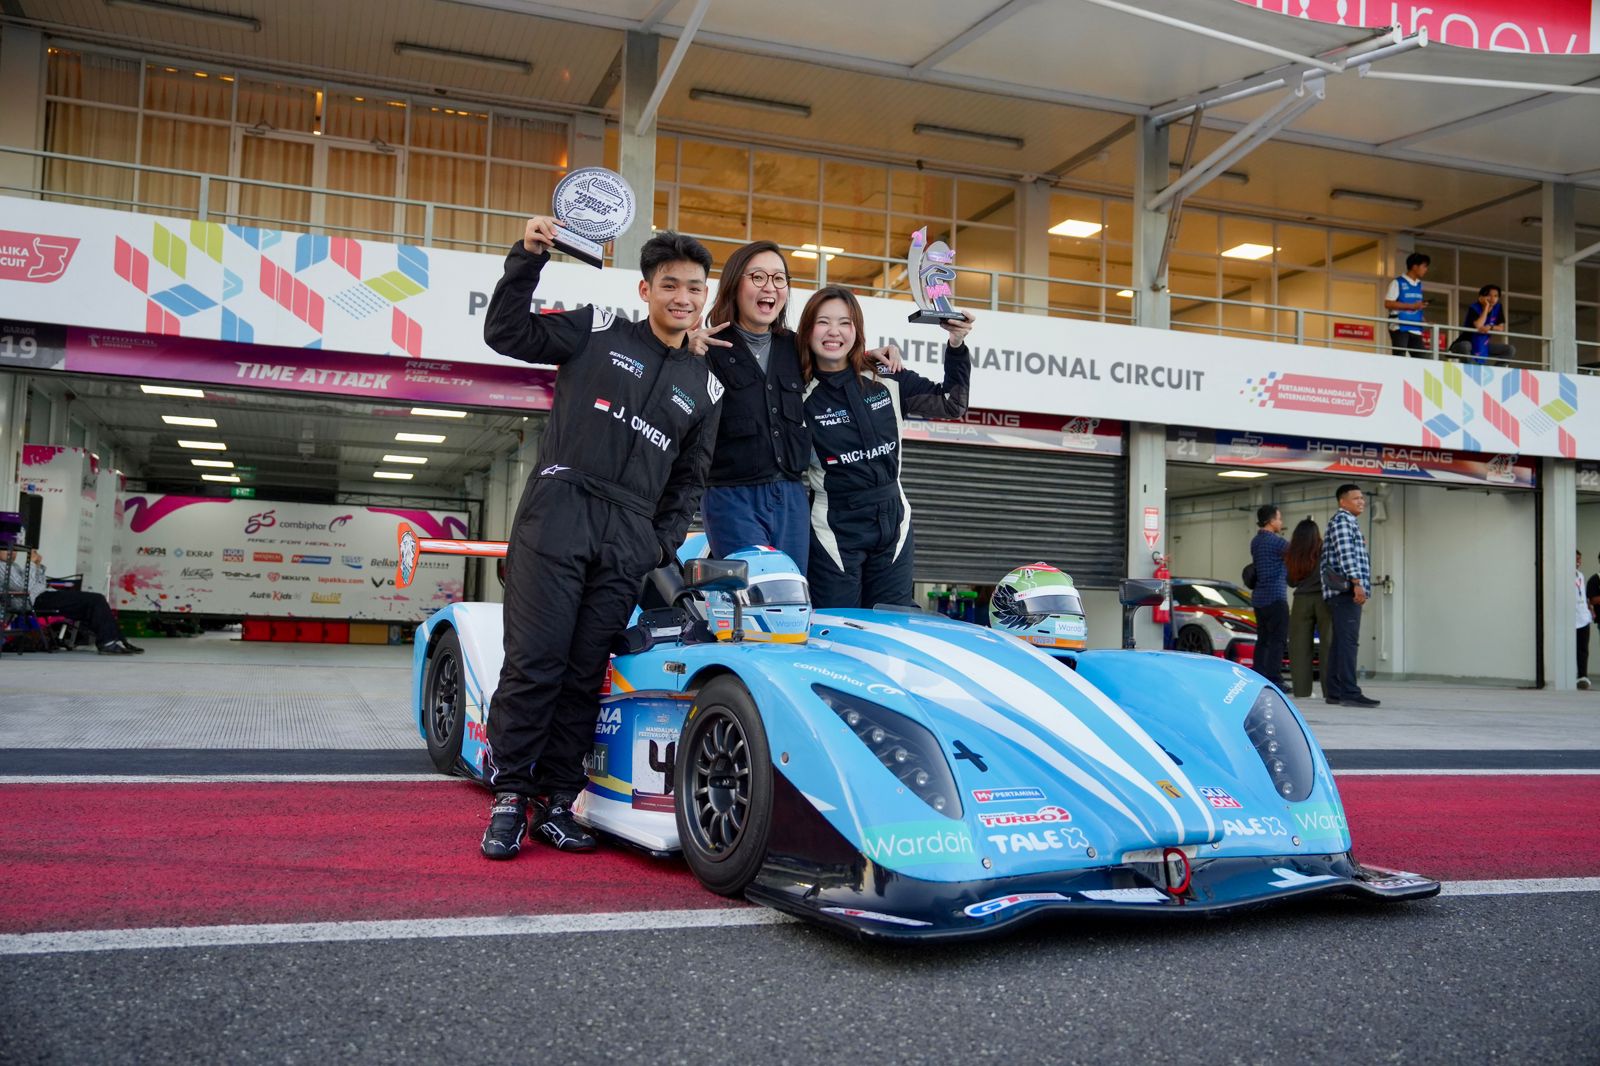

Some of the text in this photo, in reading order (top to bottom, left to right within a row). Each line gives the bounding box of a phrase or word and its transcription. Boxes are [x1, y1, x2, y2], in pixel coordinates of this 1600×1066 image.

[589, 172, 611, 180] GRAND
[3, 326, 35, 334] GARAGE
[0, 336, 38, 359] 19
[405, 361, 452, 371] RACE
[612, 358, 635, 373] TALE
[879, 336, 1205, 391] INTENATIONAL CIRCUIT
[235, 362, 392, 389] TIME ATTACK
[404, 374, 473, 387] HEALTH
[1278, 384, 1357, 398] PERTAMINA MANDALIKA
[1278, 392, 1356, 406] INTERNATIONAL CIRCUIT
[613, 406, 671, 451] J. OWEN
[820, 417, 842, 426] TALE
[1177, 437, 1199, 456] 21
[1306, 440, 1453, 464] Honda RACING
[1340, 457, 1420, 472] INDONESIA
[1580, 469, 1599, 486] 22
[280, 520, 327, 531] combiphar
[186, 549, 215, 558] EKRAF
[793, 661, 865, 687] combiphar
[982, 813, 1057, 825] TURBO
[987, 830, 1063, 854] TALE
